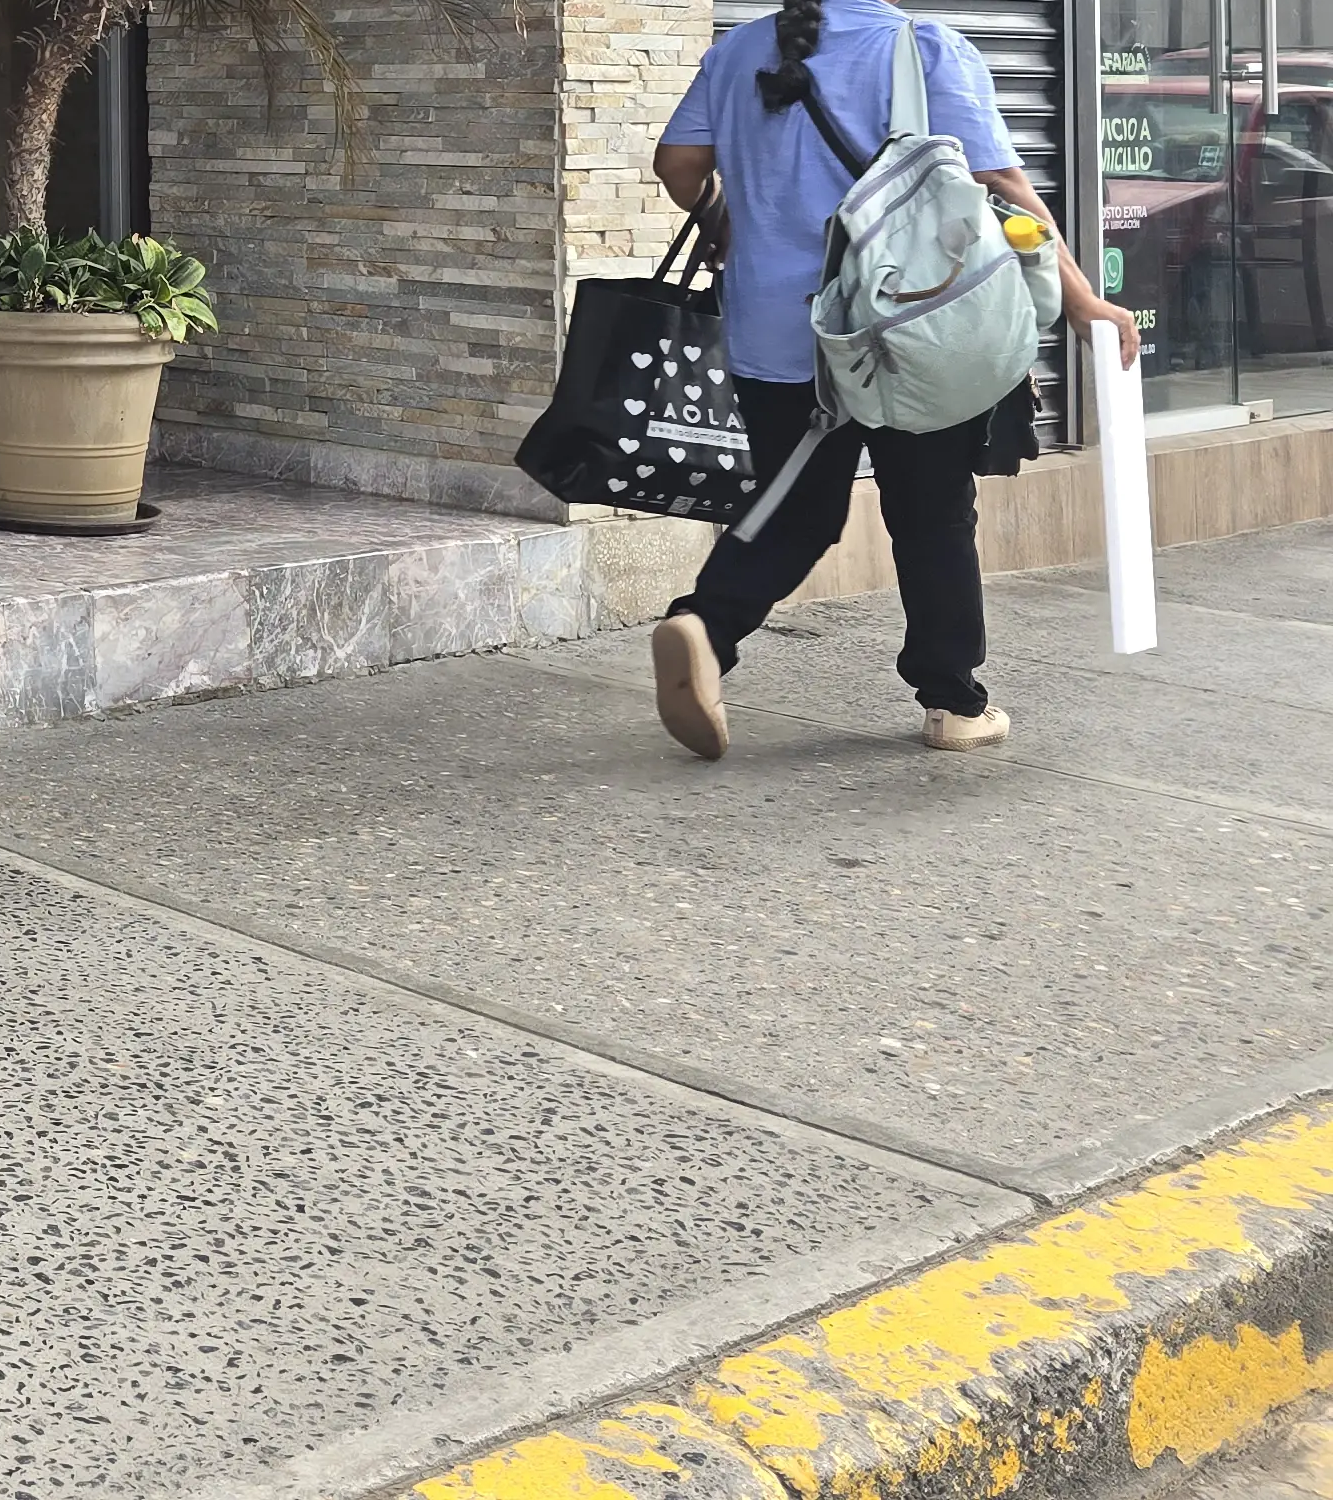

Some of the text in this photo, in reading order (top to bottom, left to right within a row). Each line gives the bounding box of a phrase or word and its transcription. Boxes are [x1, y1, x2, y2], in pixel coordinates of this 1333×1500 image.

[1139, 117, 1152, 141] A
[1123, 205, 1148, 219] EXTRA
[650, 402, 742, 429] AOLA
